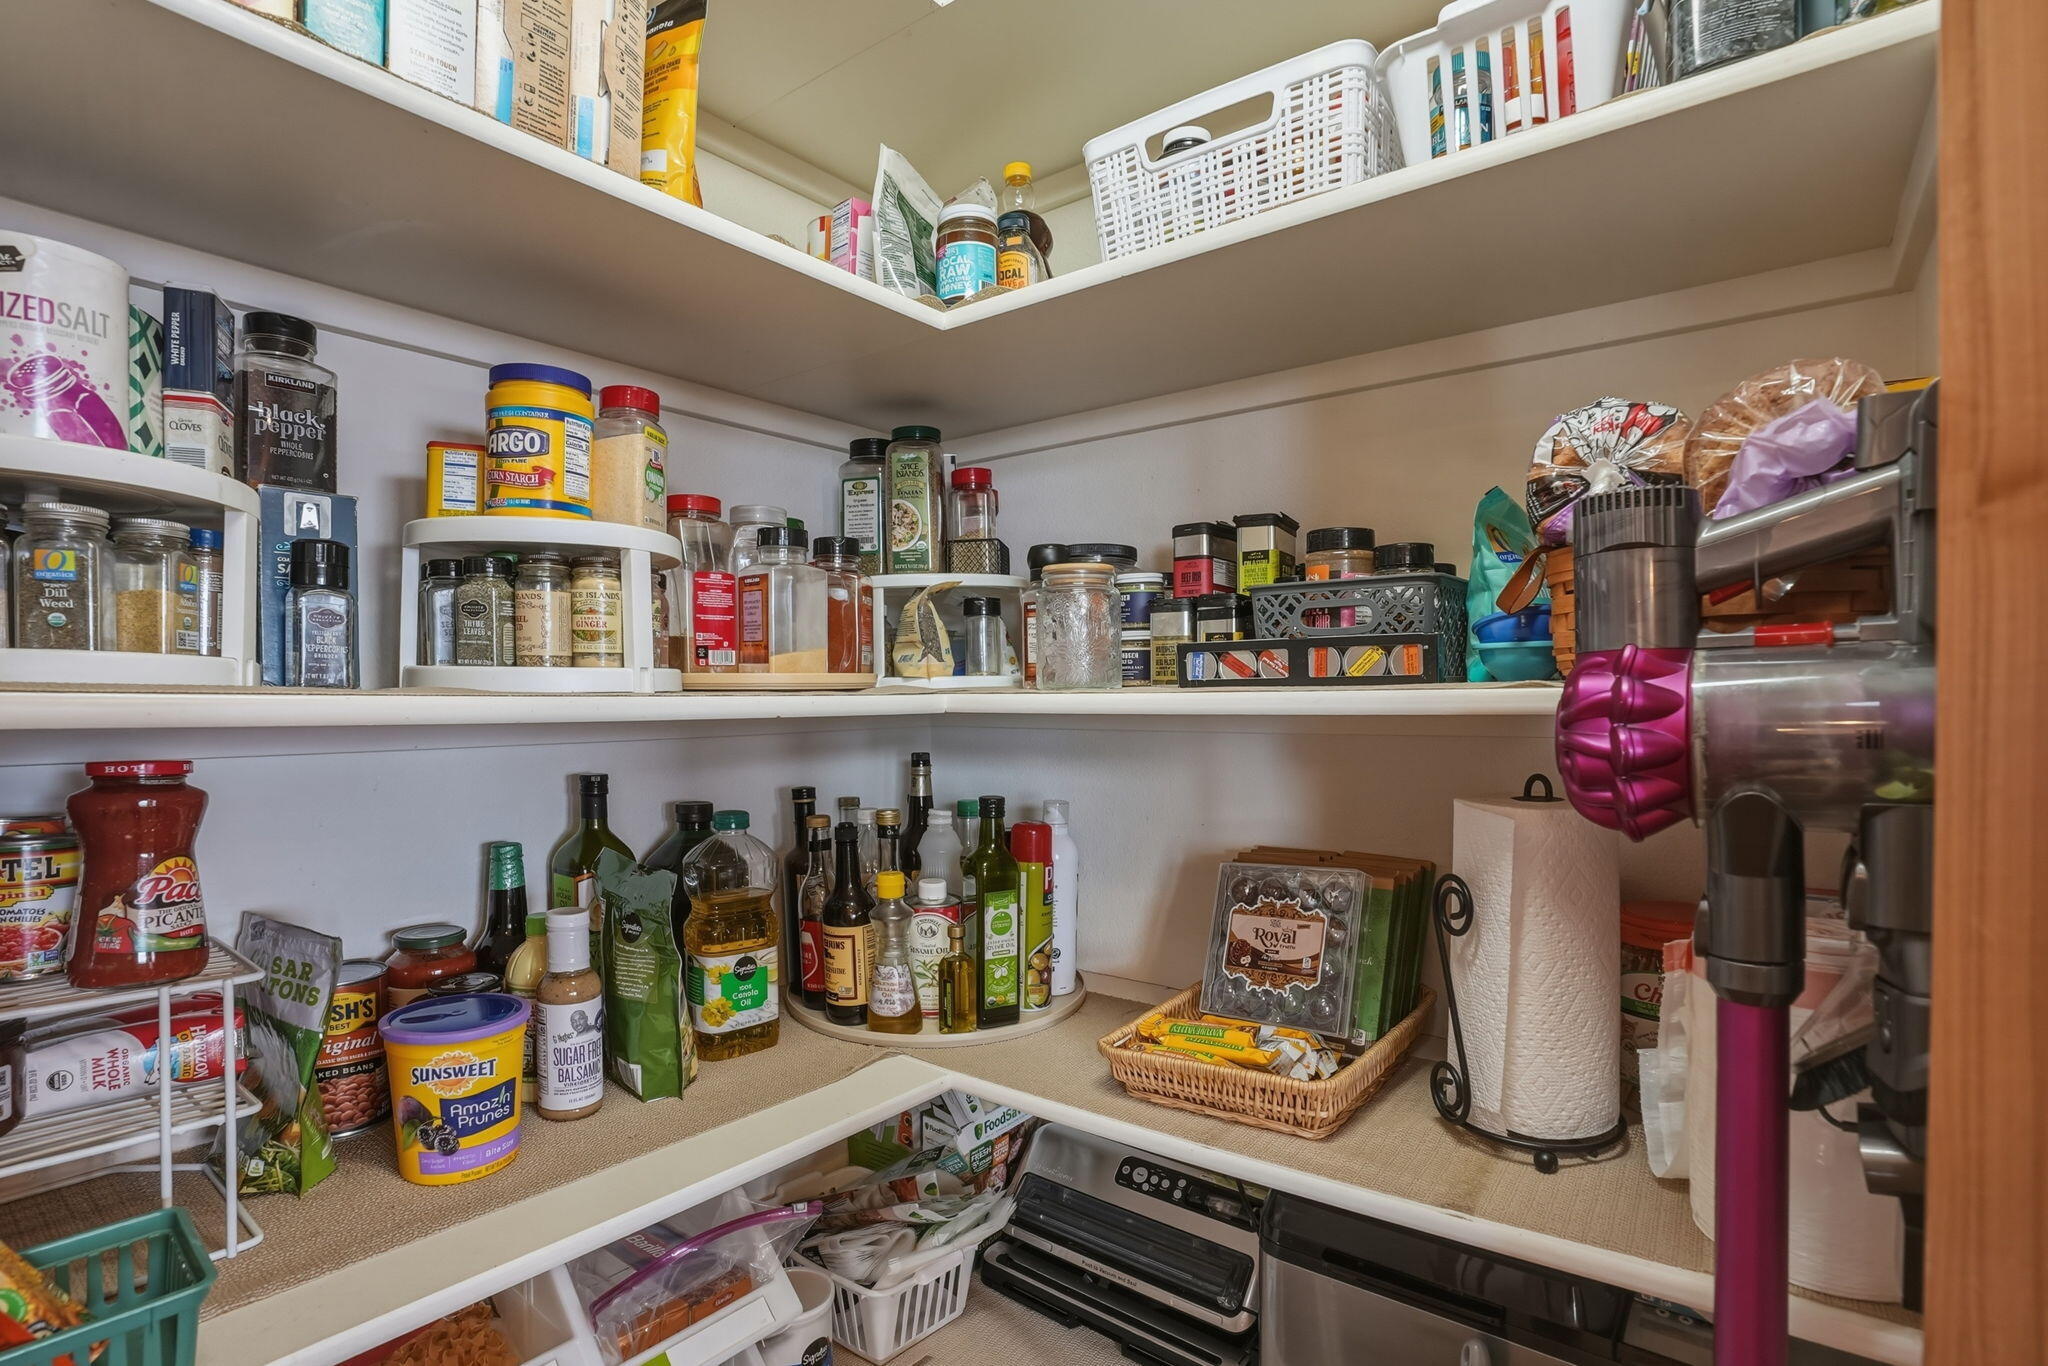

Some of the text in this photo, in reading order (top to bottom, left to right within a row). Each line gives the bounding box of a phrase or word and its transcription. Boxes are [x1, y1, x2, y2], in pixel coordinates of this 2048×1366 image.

[435, 58, 458, 73] TOUCH
[1000, 268, 1024, 280] OCAL
[0, 291, 110, 339] IZED SALT
[171, 311, 181, 366] WHITE PEPPER
[267, 374, 315, 390] KIRKLAND
[257, 401, 326, 430] black
[169, 421, 202, 433] CLOVES
[254, 418, 327, 441] pepper
[280, 440, 302, 452] WHOLE
[488, 431, 541, 453] ARGO
[269, 447, 314, 460] PEPPERCORNS
[896, 469, 924, 477] ISLANDS
[900, 462, 919, 470] SPICE
[505, 472, 539, 484] STARCH
[44, 588, 69, 598] Dill
[585, 592, 620, 600] ISLANDS
[39, 599, 75, 609] Weed
[575, 620, 607, 629] GINGER
[316, 635, 337, 645] BLACK
[1, 856, 61, 882] TEL
[0, 888, 46, 901] ginal
[0, 907, 46, 916] OMATOES
[824, 939, 846, 950] ERRINS
[1252, 926, 1297, 949] Royal
[271, 955, 314, 981] SAR
[267, 976, 321, 1007] TONS
[732, 989, 759, 999] Canola
[331, 997, 374, 1022] SH'S
[740, 998, 752, 1007] Oil
[329, 1021, 351, 1031] BEST
[190, 1024, 210, 1078] HORIZON
[322, 1031, 378, 1056] iginal
[553, 1045, 586, 1067] SUGAR
[91, 1057, 107, 1091] MILK
[107, 1047, 121, 1092] WHOLE
[121, 1048, 131, 1087] ORGANIC
[318, 1062, 375, 1079] KED BEANS
[411, 1059, 497, 1086] SUNSWEET
[457, 1104, 511, 1129] Prunes
[983, 1106, 1021, 1135] FoodSav
[485, 1146, 501, 1158] Bite
[971, 1145, 992, 1162] FRESH
[626, 1233, 666, 1259] Barilla
